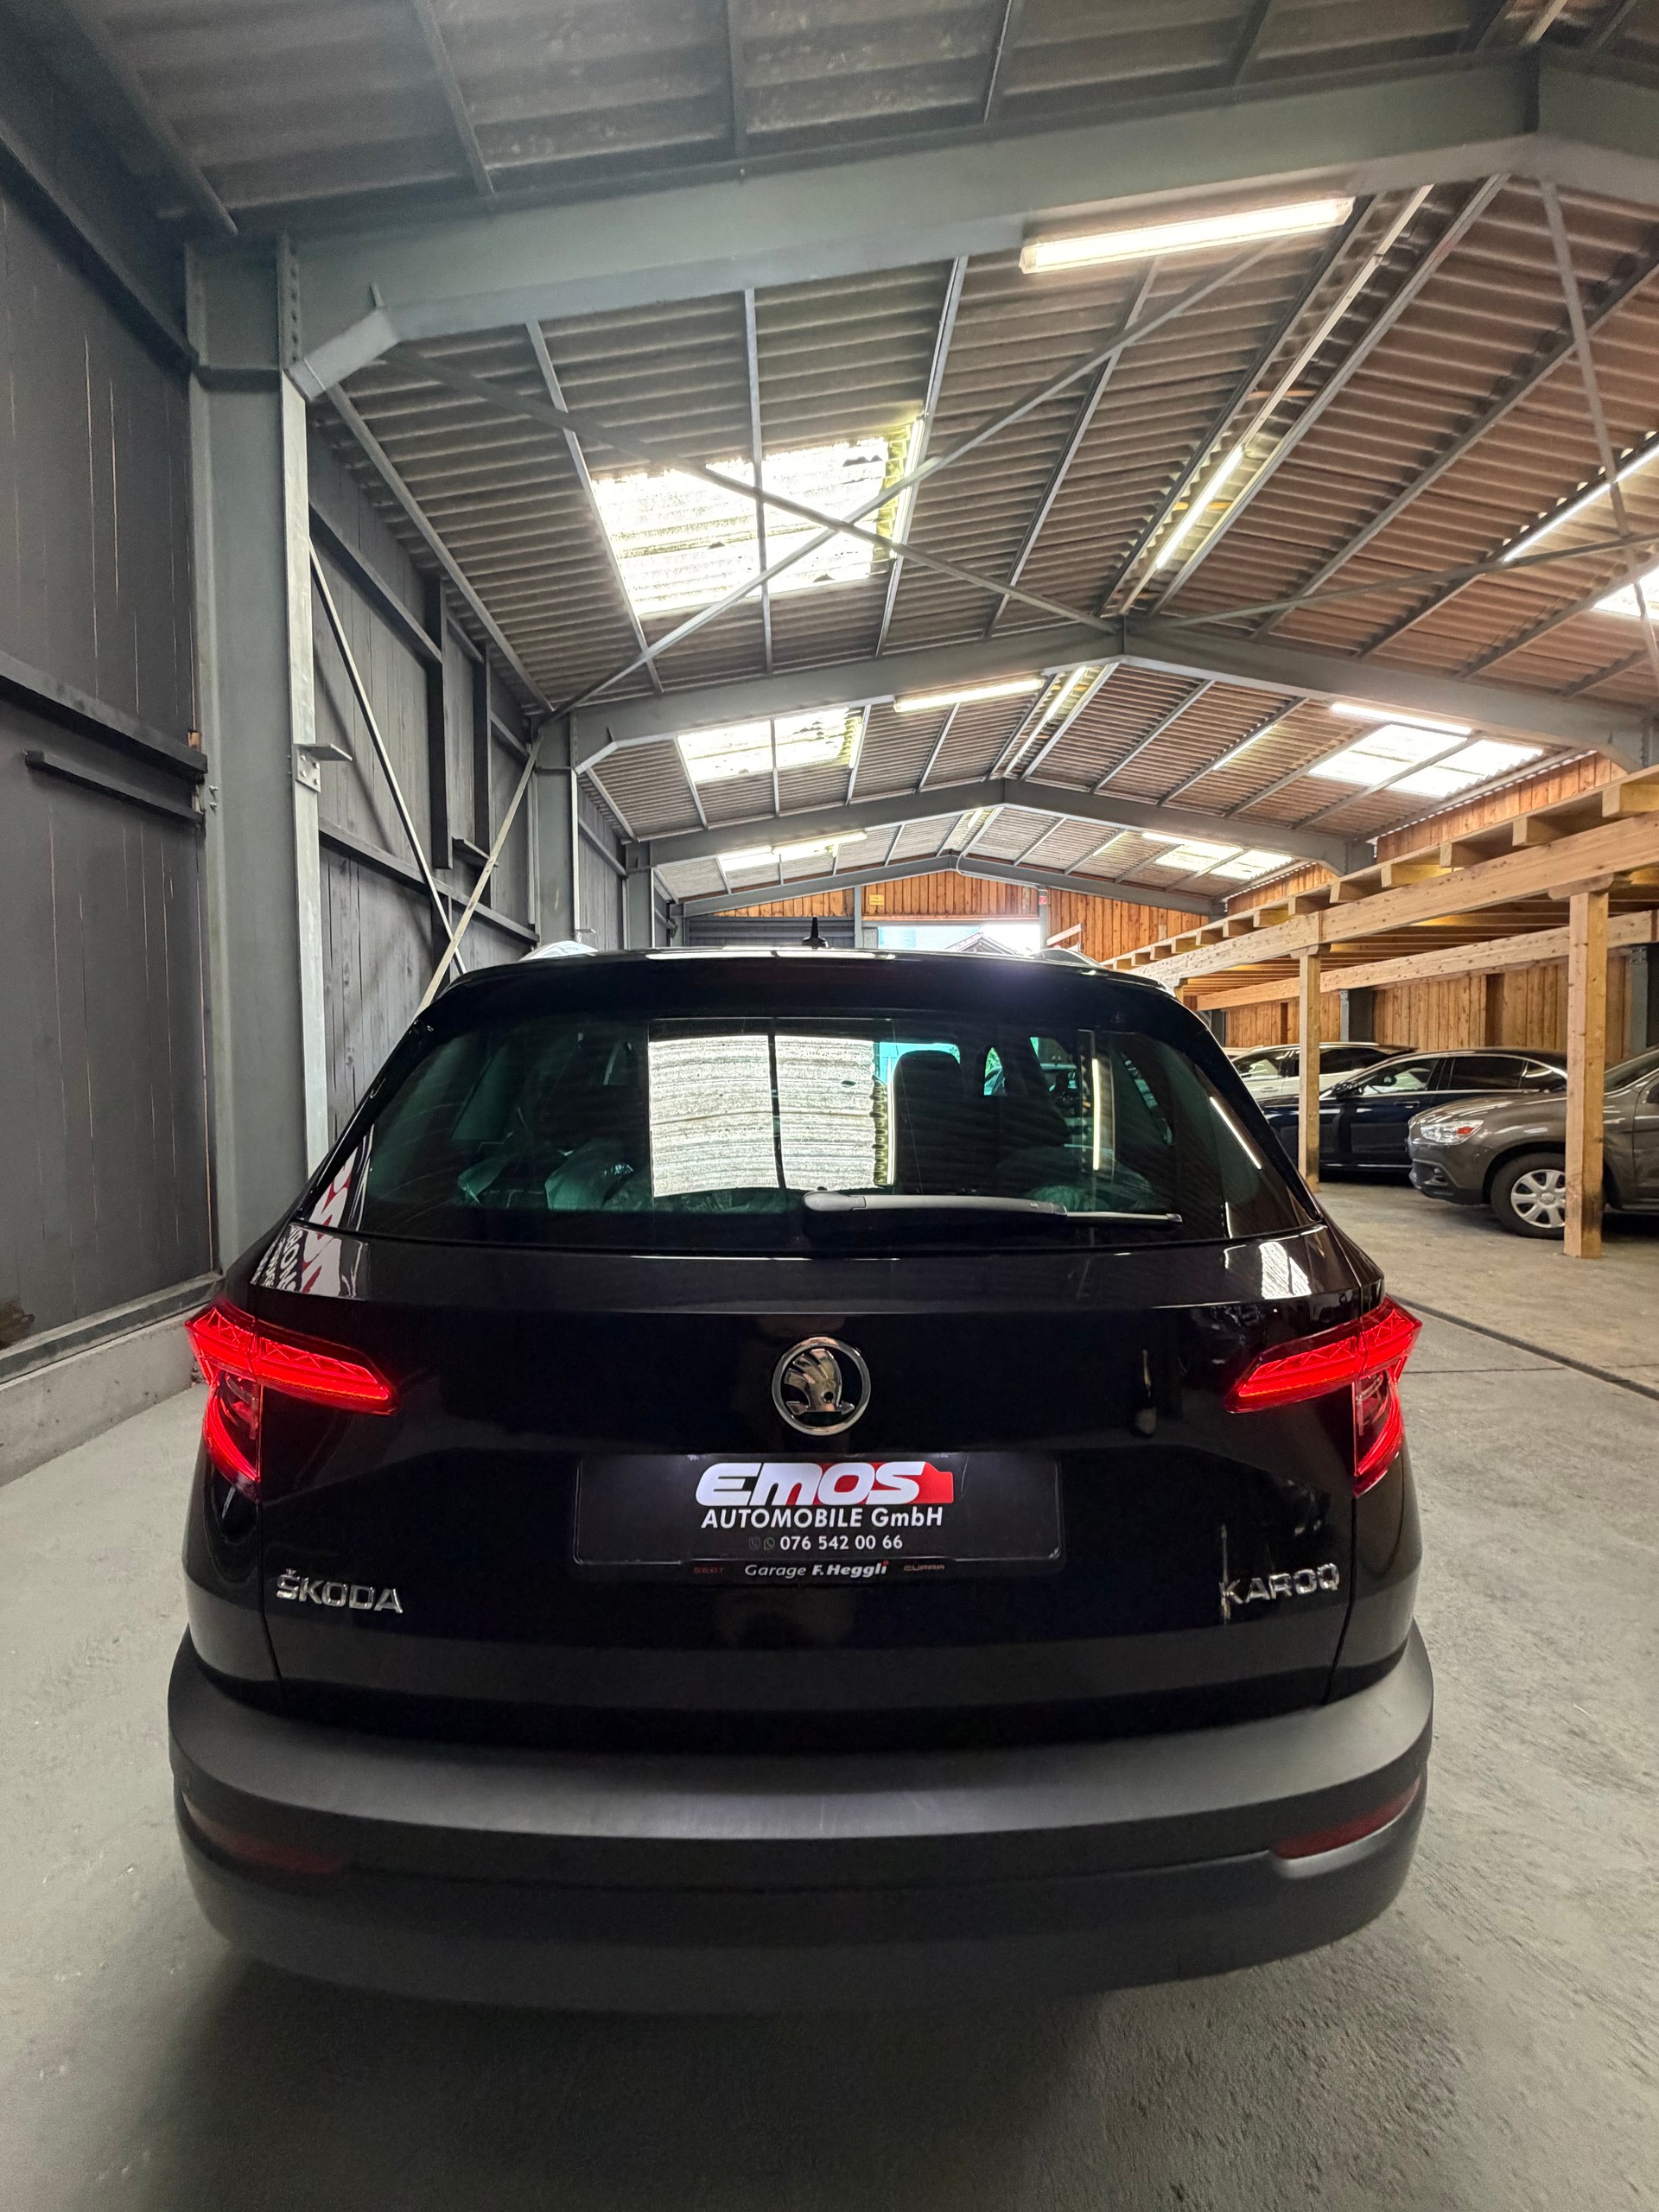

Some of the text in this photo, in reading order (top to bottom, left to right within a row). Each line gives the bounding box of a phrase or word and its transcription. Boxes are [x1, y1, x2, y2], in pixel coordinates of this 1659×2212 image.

[700, 1506, 944, 1529] AUTOMOBILE GmbH
[779, 1534, 903, 1551] 076 542 00 66
[744, 1564, 807, 1579] Garage
[276, 1568, 404, 1614] ŠKODA
[1219, 1562, 1340, 1605] KAROQ
